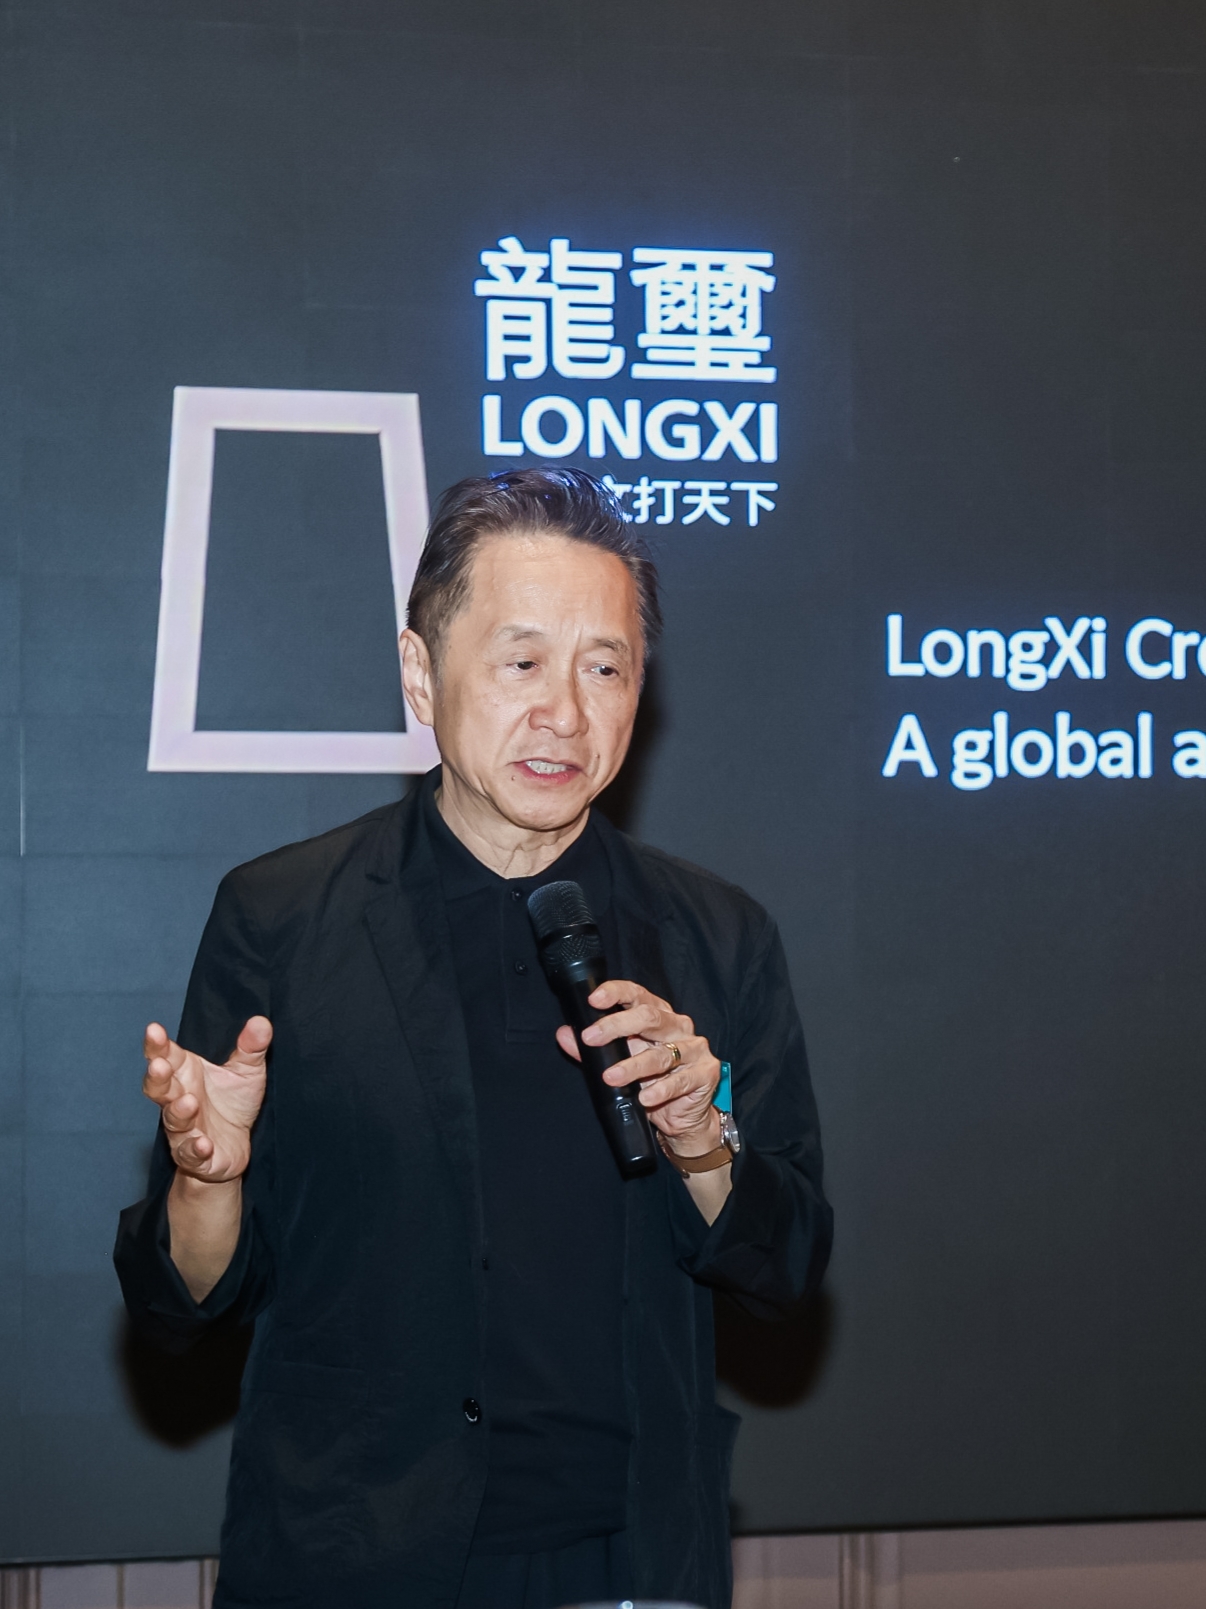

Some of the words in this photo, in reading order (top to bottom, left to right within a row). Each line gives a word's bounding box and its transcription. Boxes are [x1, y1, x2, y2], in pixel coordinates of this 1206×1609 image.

[474, 236, 777, 383] 龍璽
[482, 394, 778, 462] LONGXI
[886, 613, 1107, 692] LongXi
[881, 714, 938, 779] A
[951, 710, 1152, 791] global
